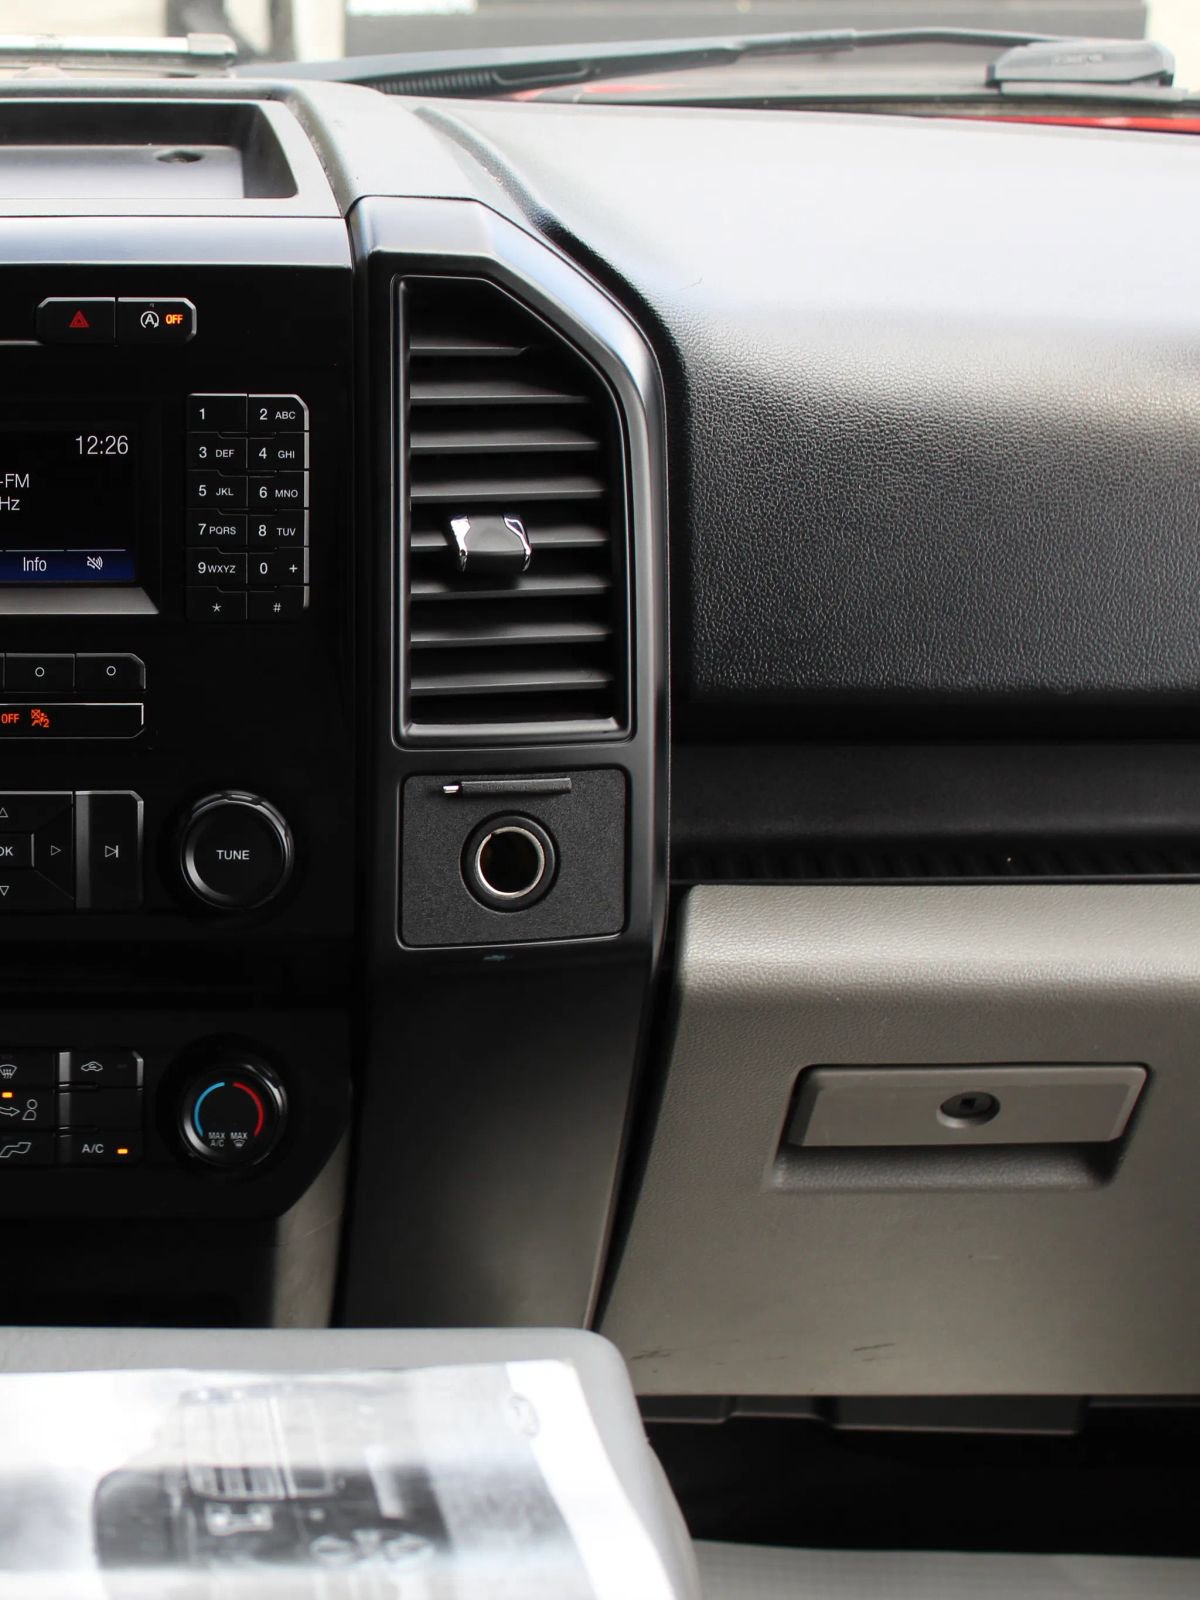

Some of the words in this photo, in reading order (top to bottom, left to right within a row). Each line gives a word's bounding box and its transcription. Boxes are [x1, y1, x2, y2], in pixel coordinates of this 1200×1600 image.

[165, 313, 184, 325] OFF
[199, 407, 205, 420] 1
[259, 407, 268, 421] 2
[275, 410, 296, 420] ABC
[75, 435, 129, 455] 12:26
[198, 446, 208, 459] 3
[215, 449, 235, 458] DEF
[258, 447, 268, 460] 4
[277, 450, 295, 459] GHI
[198, 484, 207, 497] 5
[215, 487, 234, 496] JKL
[259, 486, 268, 499] 6
[274, 489, 299, 498] MNO
[198, 523, 207, 536] 7
[209, 526, 237, 535] PQRS
[258, 524, 267, 537] 8
[276, 527, 296, 537] TUV
[23, 556, 47, 572] Info
[197, 561, 207, 574] 9
[207, 564, 236, 574] WXYZ
[259, 562, 268, 575] 0
[0, 713, 20, 724] OFF
[216, 849, 250, 860] TUNE
[207, 1130, 226, 1140] MAX
[230, 1130, 248, 1140] MAX
[81, 1143, 105, 1154] A/C
